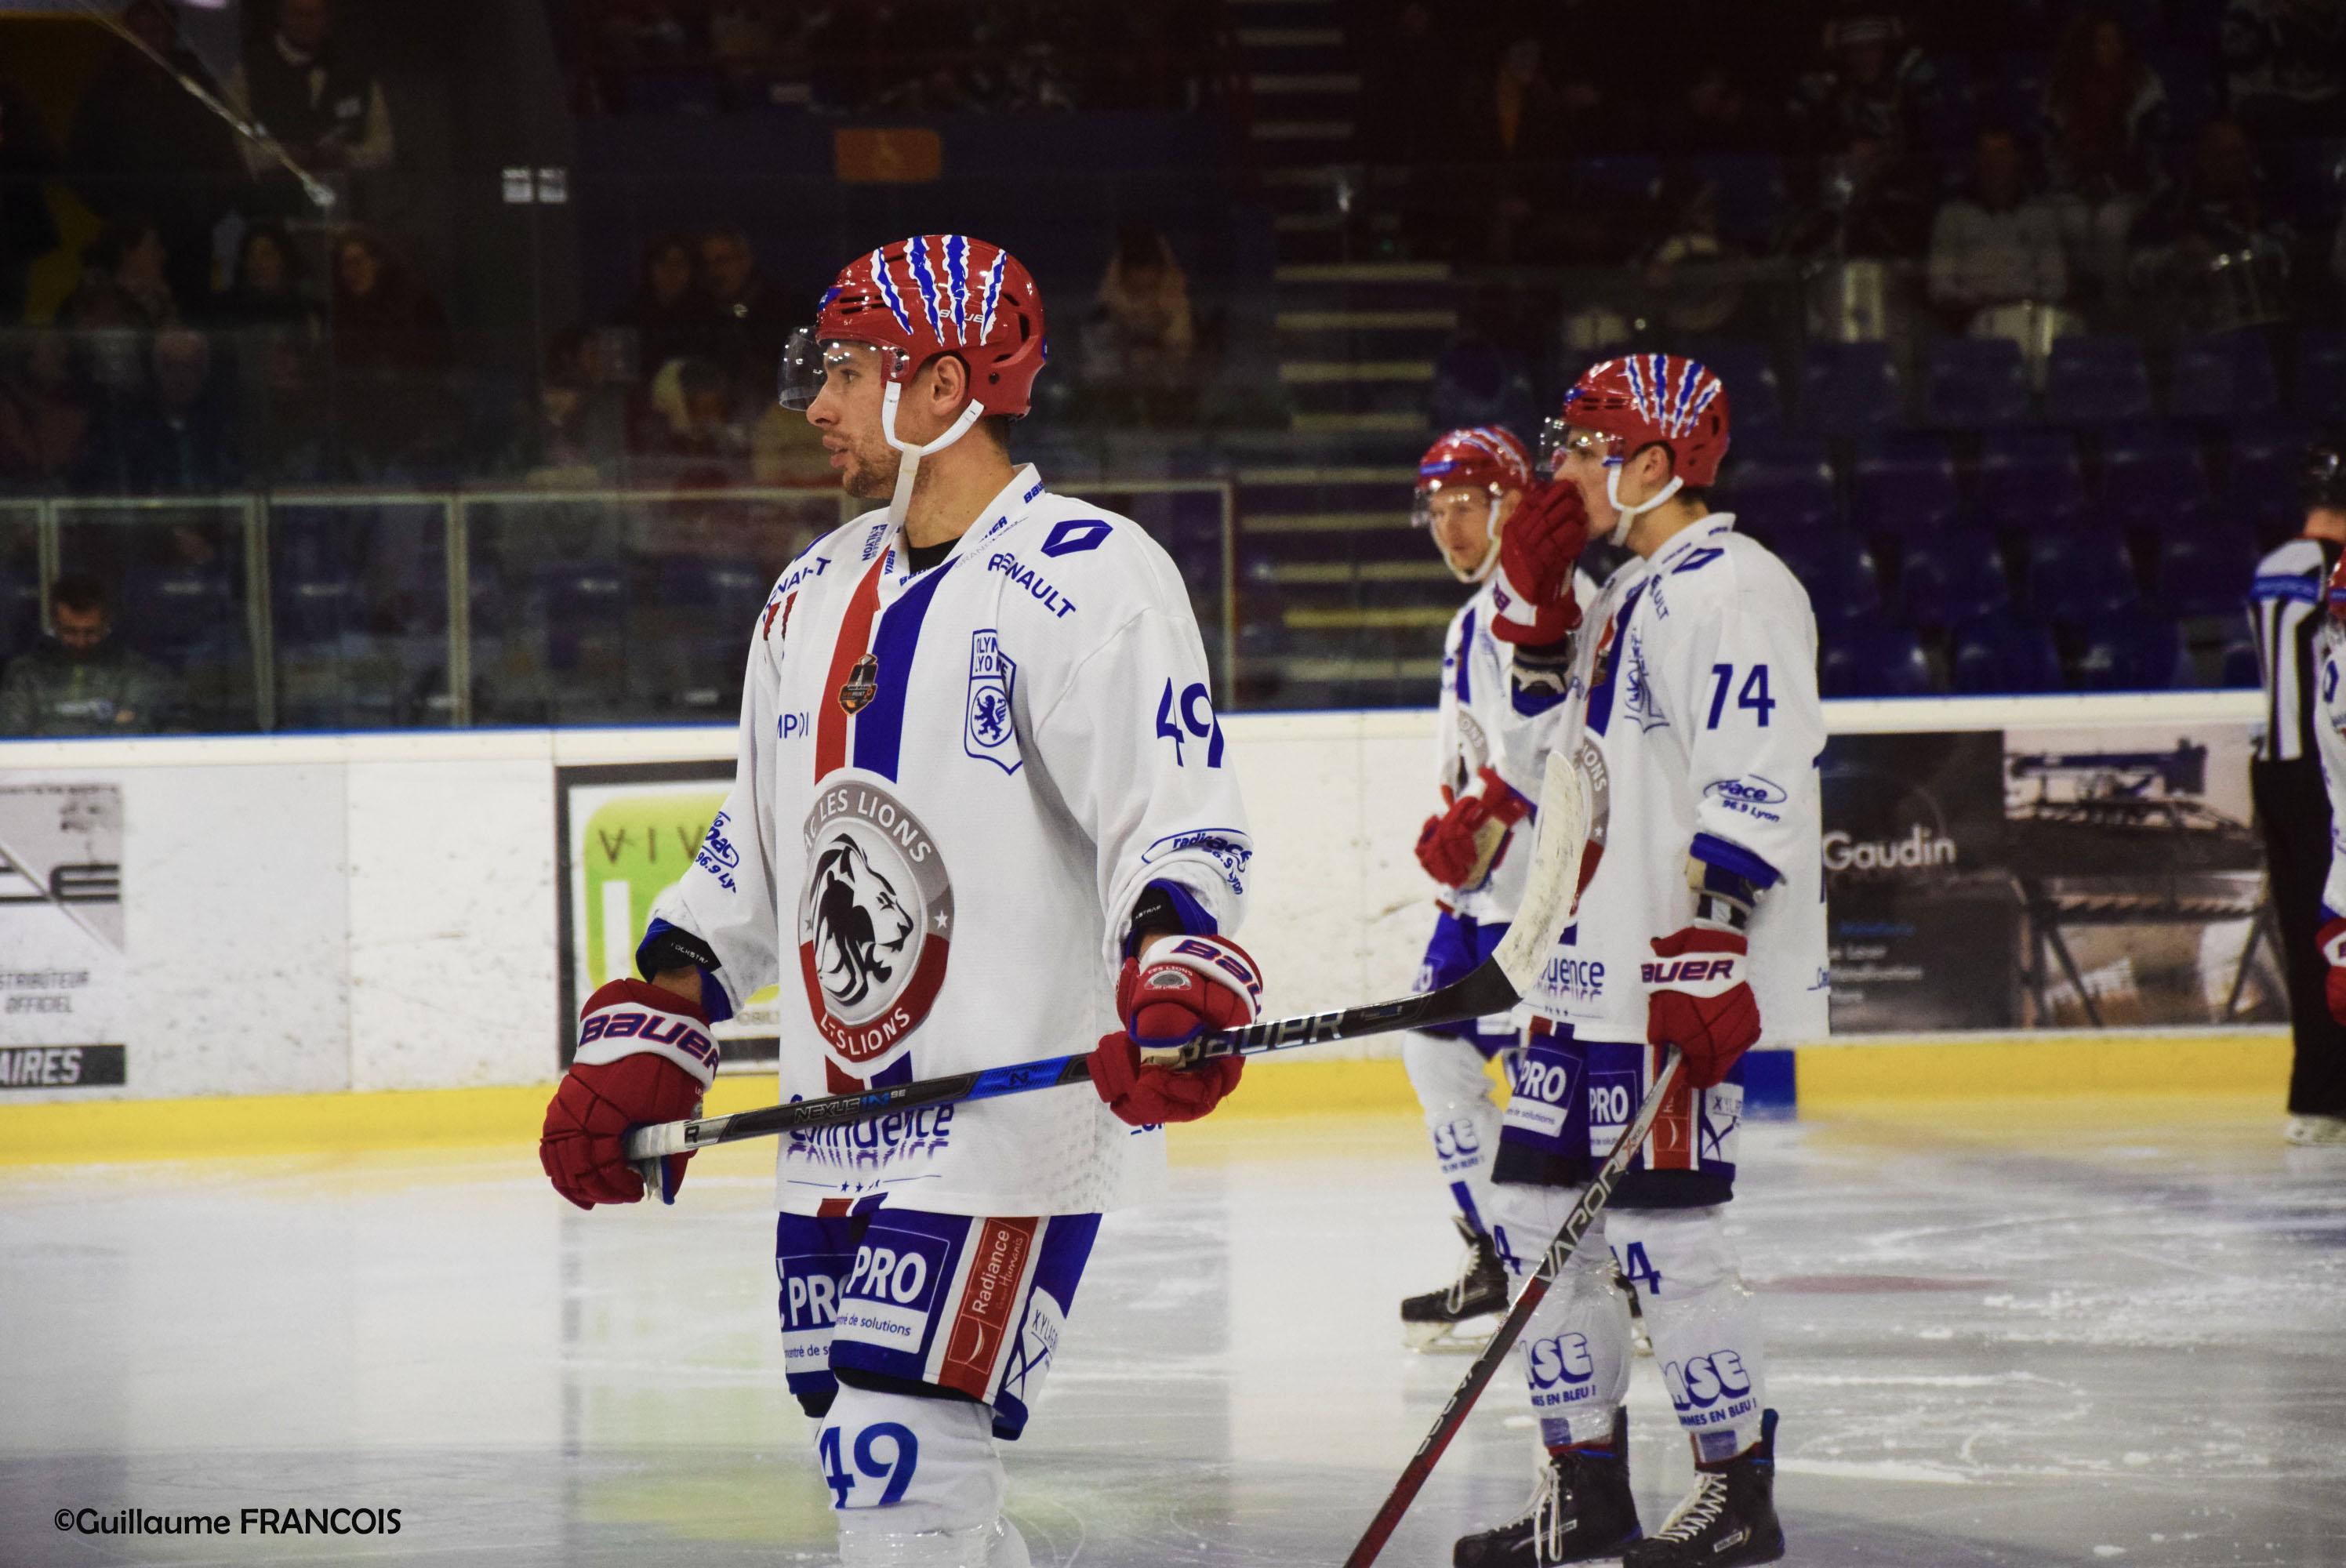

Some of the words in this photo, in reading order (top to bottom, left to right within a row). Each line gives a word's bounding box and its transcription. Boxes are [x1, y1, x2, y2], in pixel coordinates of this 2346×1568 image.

[987, 552, 1077, 619] RENAULT
[1157, 677, 1225, 768] 49
[1707, 663, 1776, 730] 74
[819, 789, 848, 822] LES
[857, 791, 932, 864] LIONS
[1822, 823, 1958, 871] Gaudin
[578, 1012, 719, 1081] BAUER
[848, 1007, 911, 1057] LIONS
[1514, 1060, 1567, 1103] PRO
[1589, 1084, 1629, 1123] PRO
[794, 1097, 861, 1123] NEXUS
[1534, 1157, 1628, 1283] VAPOR
[844, 1245, 927, 1305] PRO
[971, 1229, 1011, 1315] Radiance
[788, 1274, 853, 1327] PR
[860, 1316, 912, 1337] solutions
[807, 1345, 820, 1357] de
[1563, 1386, 1589, 1403] BLEU
[1709, 1408, 1727, 1423] EN
[1727, 1399, 1752, 1418] BLEU
[819, 1421, 919, 1509] 49
